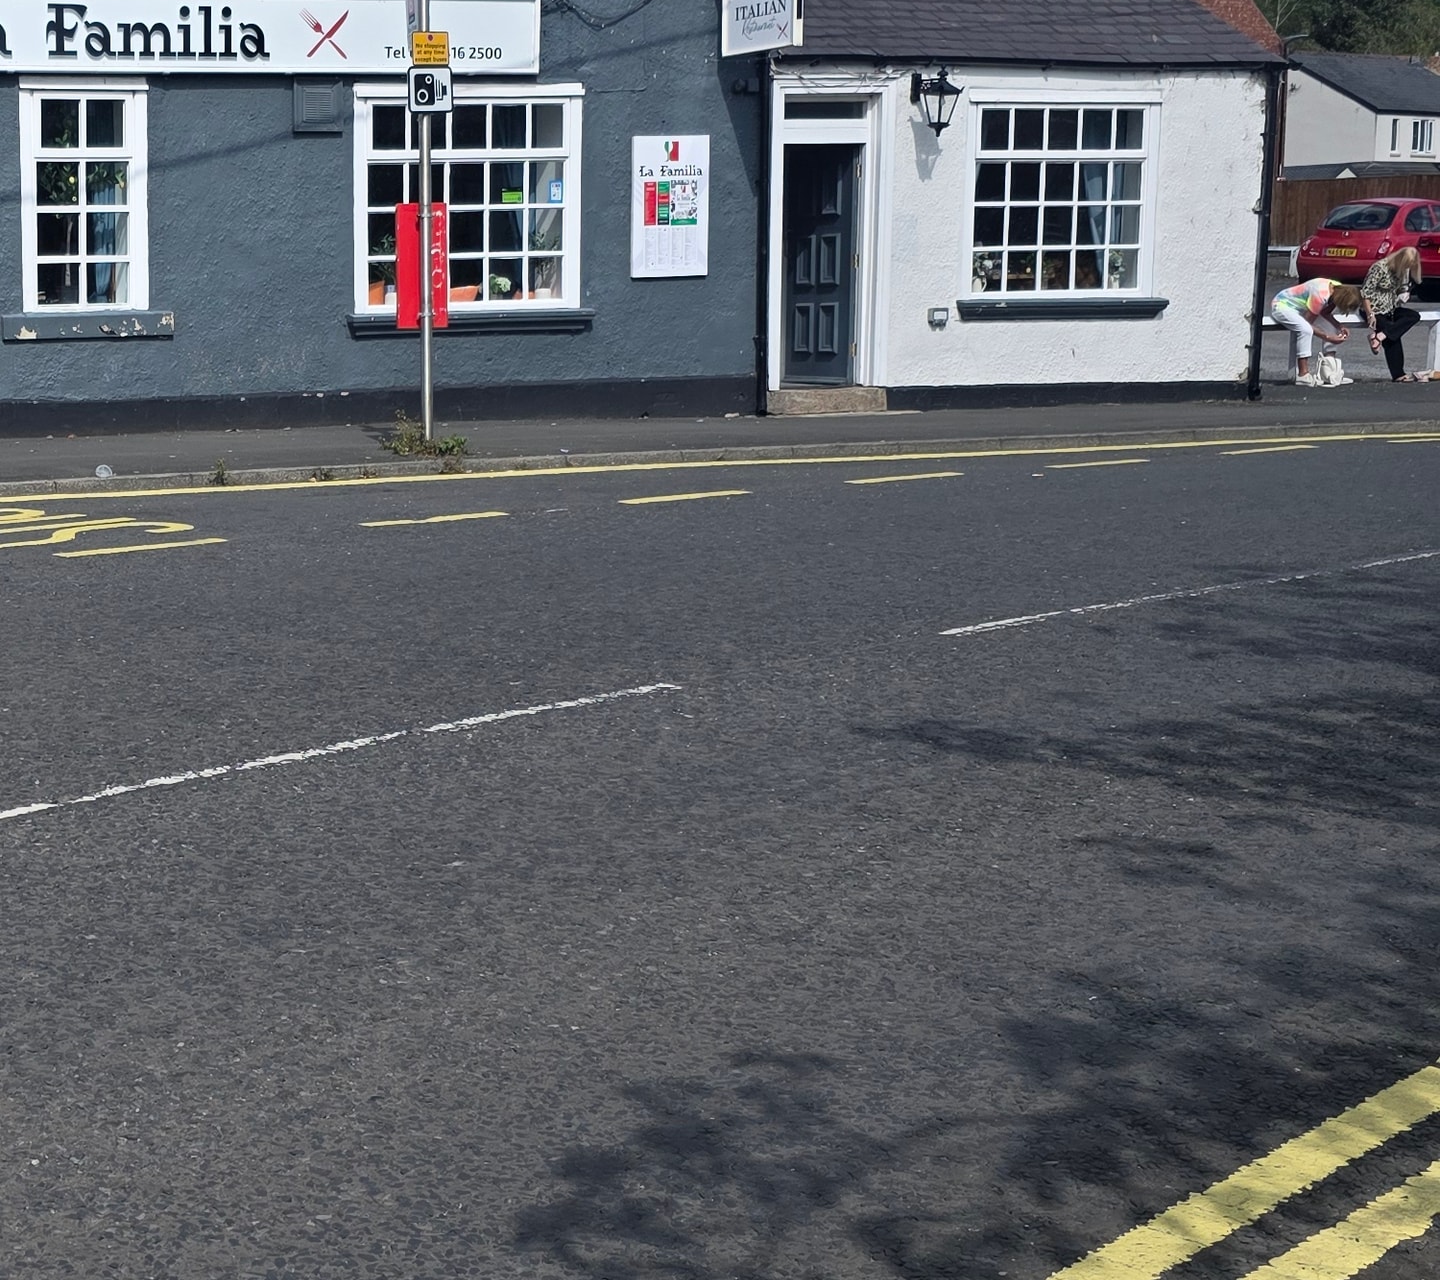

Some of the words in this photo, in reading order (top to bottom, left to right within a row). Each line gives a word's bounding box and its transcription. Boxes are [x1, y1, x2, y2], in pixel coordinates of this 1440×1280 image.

[46, 3, 270, 61] Familia
[384, 46, 406, 59] Tel
[449, 47, 465, 60] 16
[468, 47, 502, 60] 2500
[639, 165, 654, 177] La
[659, 165, 703, 177] Familia
